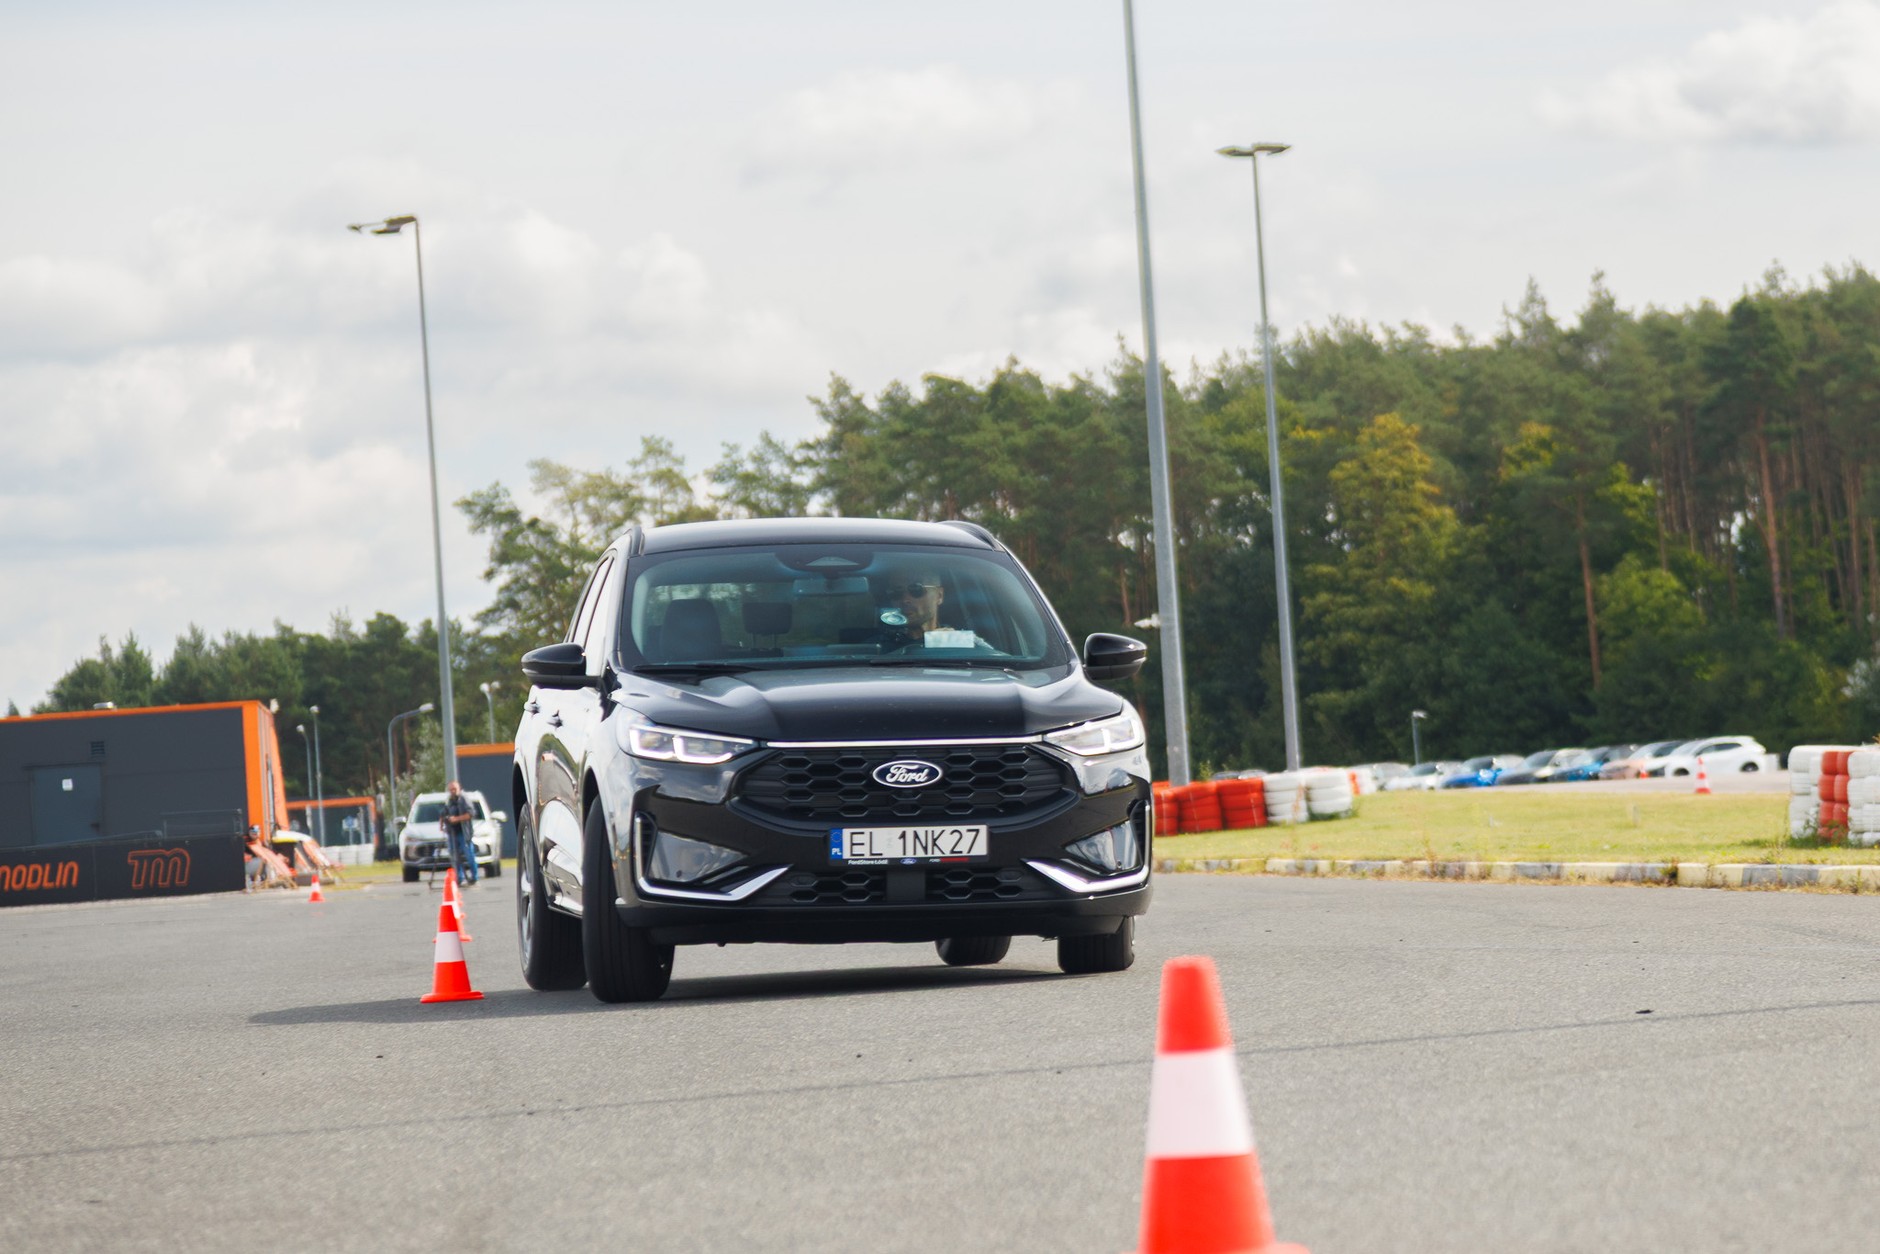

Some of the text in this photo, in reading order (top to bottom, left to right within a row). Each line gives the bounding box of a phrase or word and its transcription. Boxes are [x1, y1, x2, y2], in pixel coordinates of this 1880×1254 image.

[886, 764, 929, 783] Ford
[831, 847, 842, 856] PL
[850, 829, 980, 857] EL 1NK27
